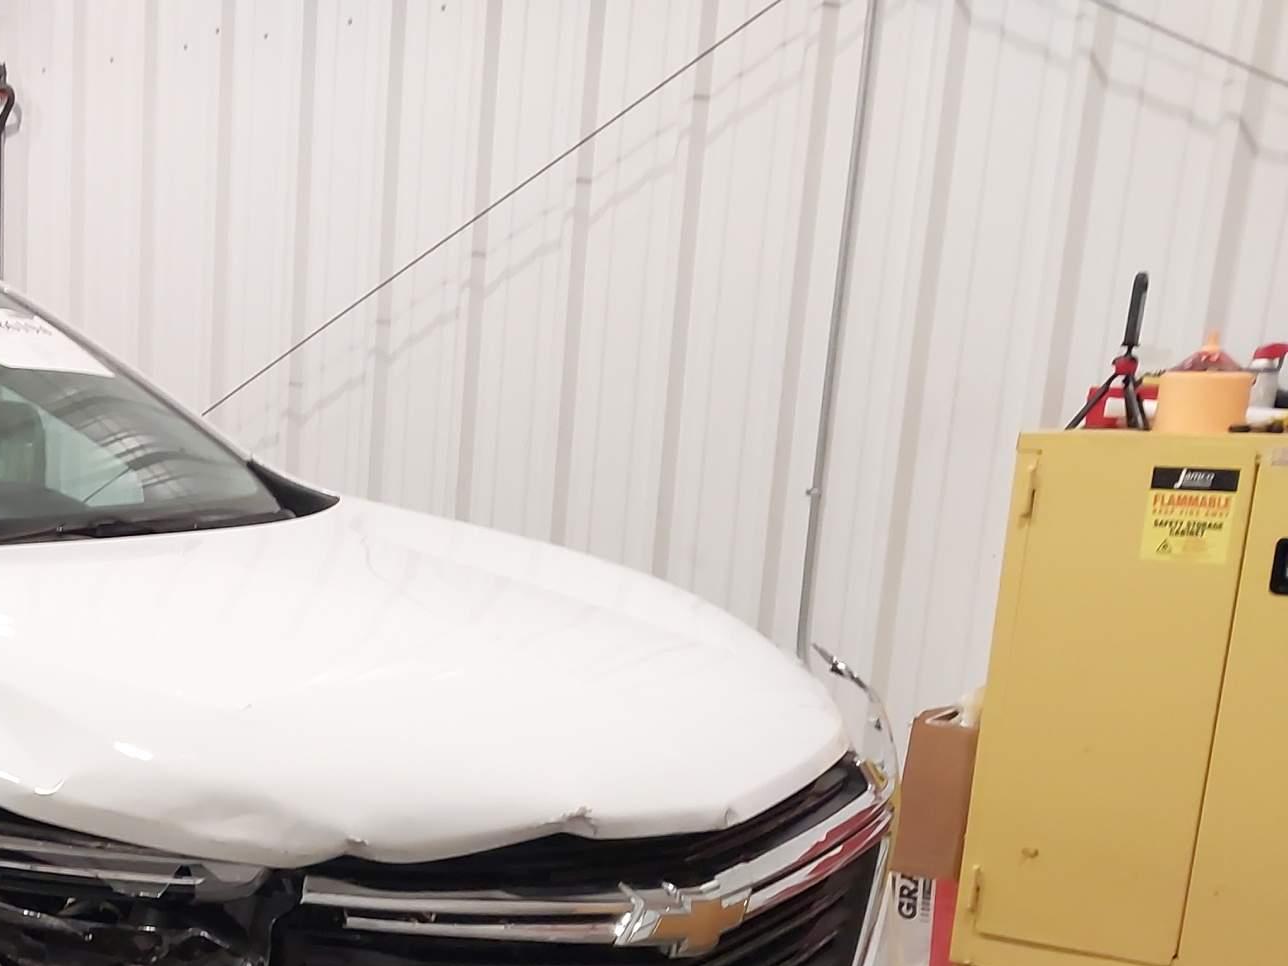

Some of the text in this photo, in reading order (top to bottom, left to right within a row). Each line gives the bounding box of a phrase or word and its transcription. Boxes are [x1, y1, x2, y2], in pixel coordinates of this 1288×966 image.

[1152, 494, 1230, 508] FLAMMABLE
[1153, 518, 1224, 530] SAFETY STORAGE
[1168, 527, 1207, 537] CABINET
